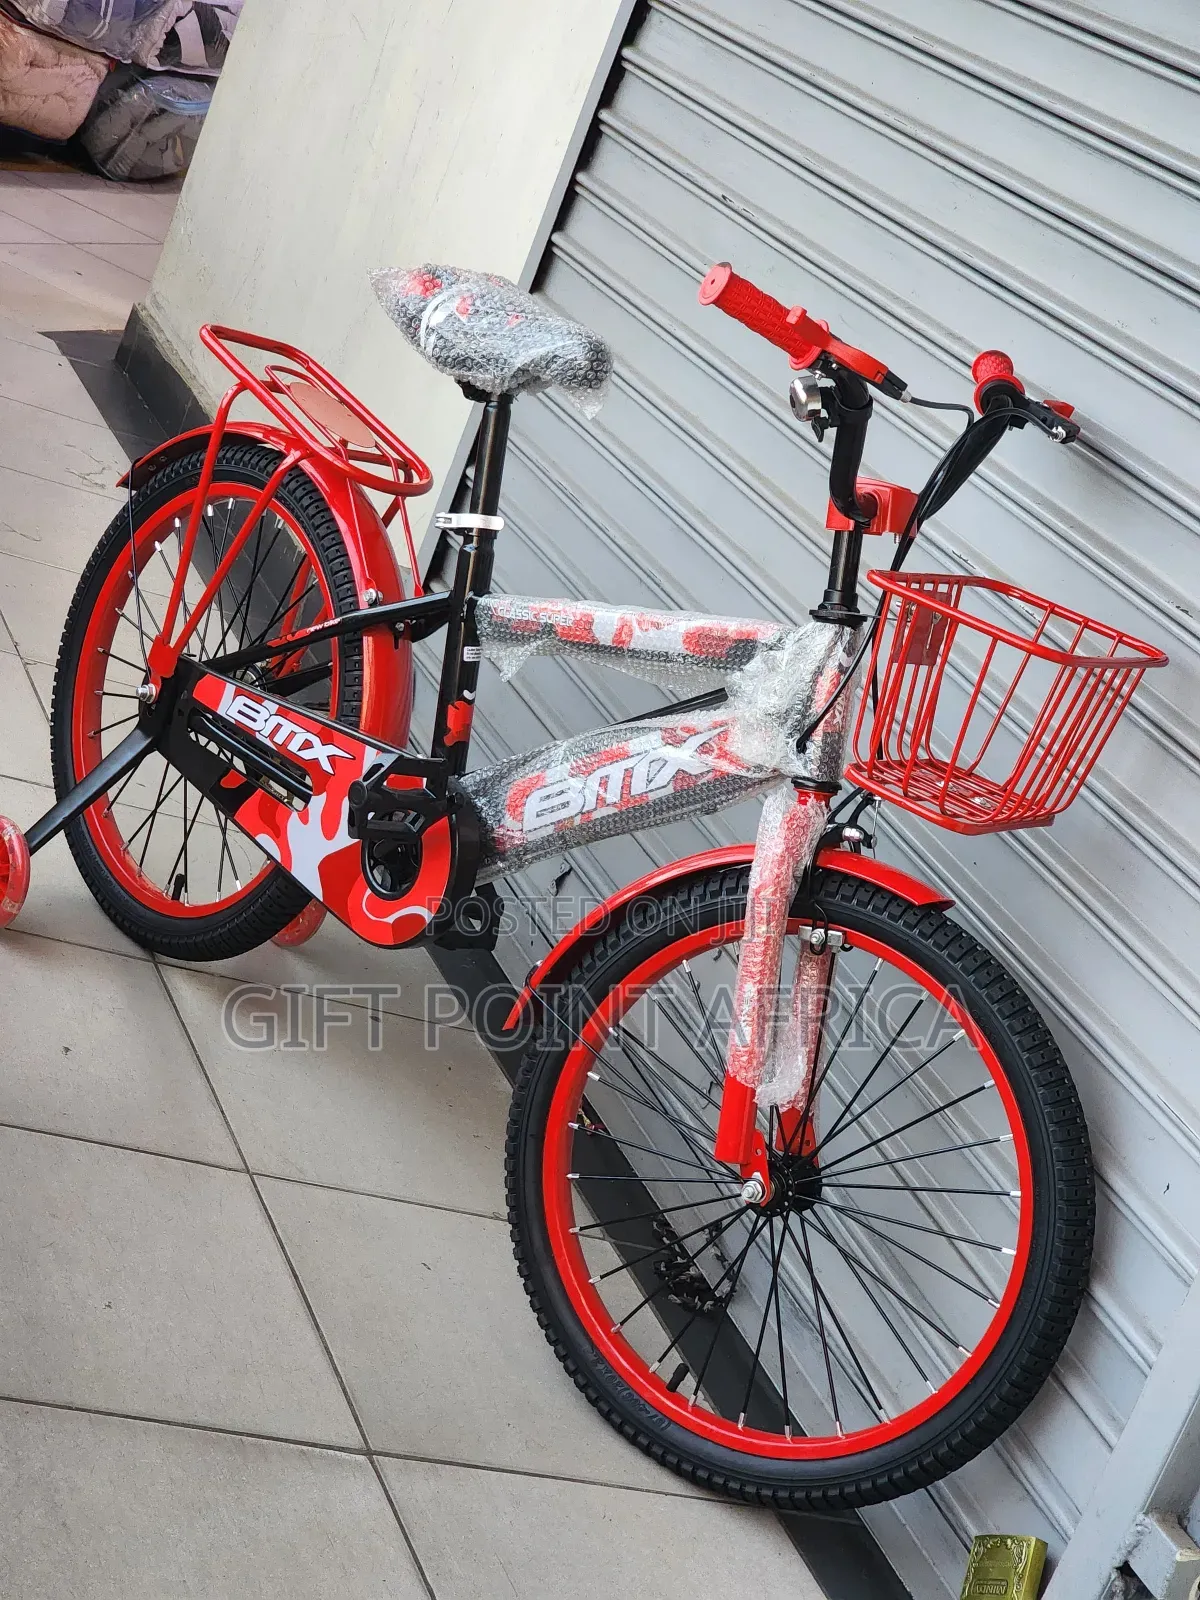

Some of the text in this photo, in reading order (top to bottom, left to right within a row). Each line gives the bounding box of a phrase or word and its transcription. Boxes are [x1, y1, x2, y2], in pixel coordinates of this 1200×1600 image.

[497, 606, 574, 627] CLASSIC SUPER
[225, 694, 356, 776] BMX
[522, 725, 731, 833] BMX
